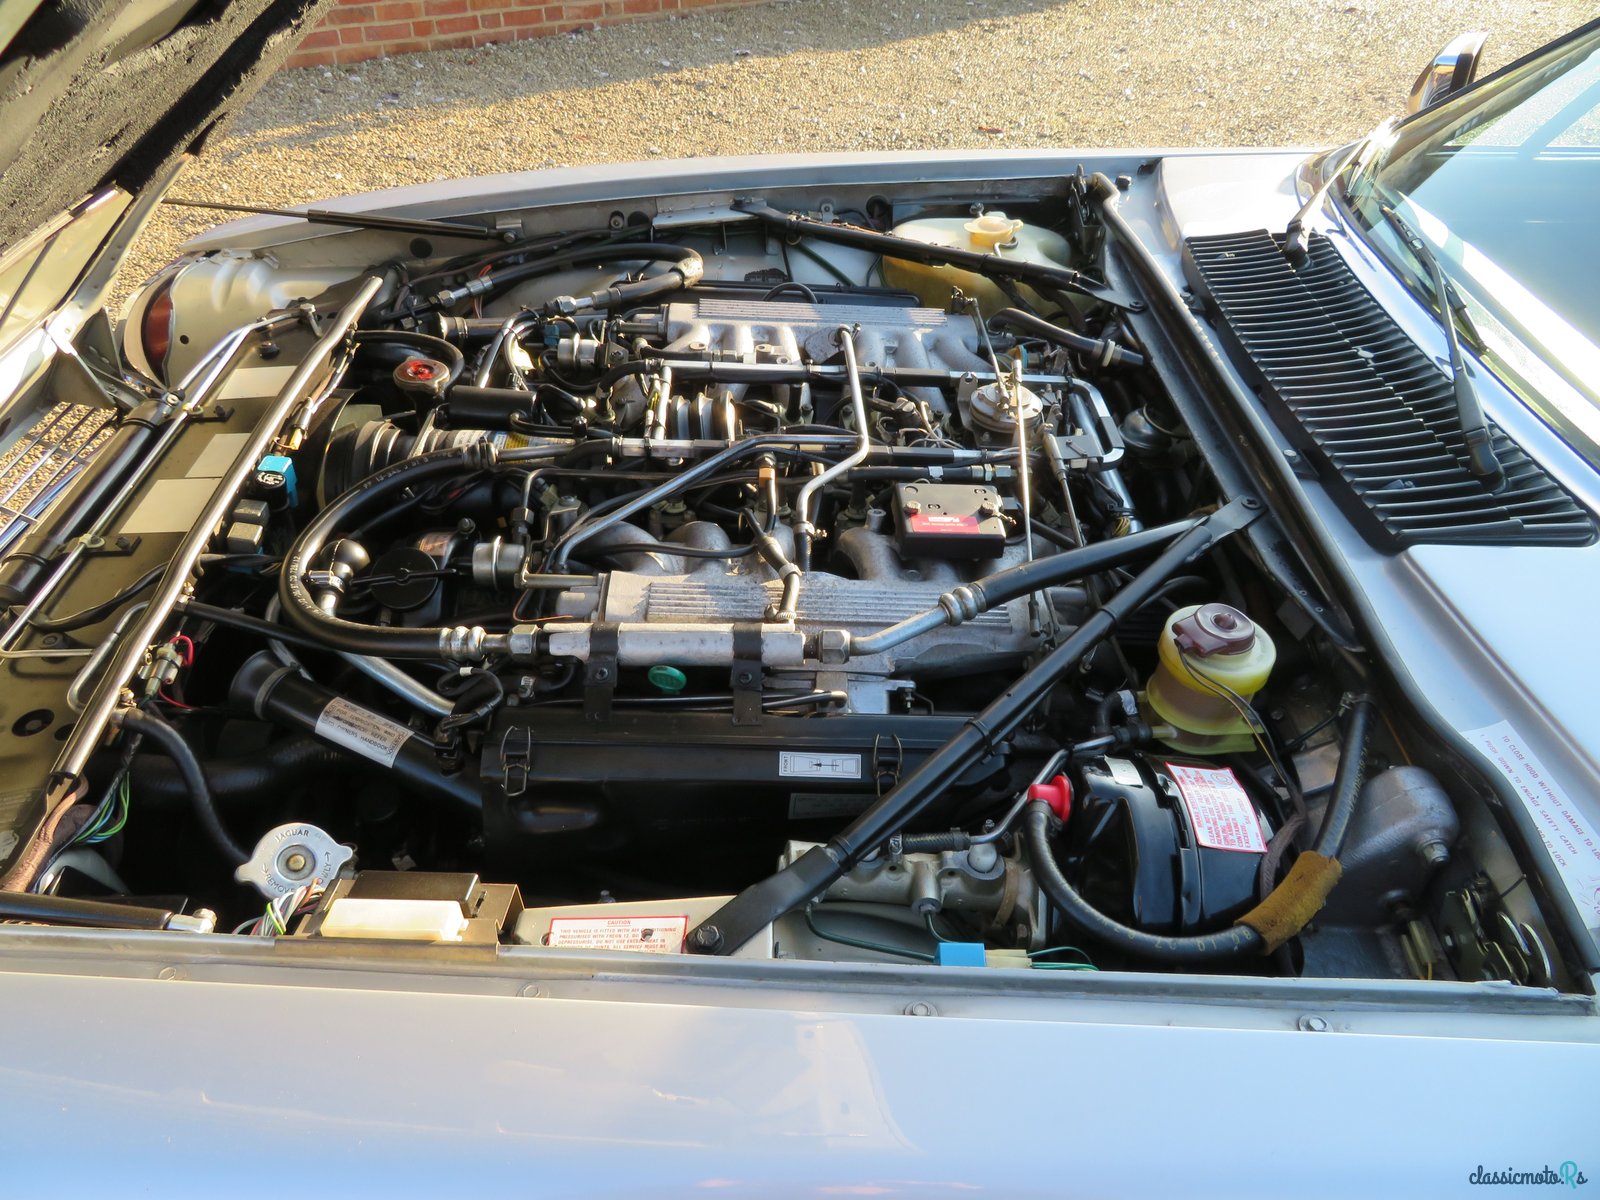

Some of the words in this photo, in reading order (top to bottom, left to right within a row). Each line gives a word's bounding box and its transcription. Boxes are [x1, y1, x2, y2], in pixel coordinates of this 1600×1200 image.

[1498, 757, 1513, 774] DOWN
[1521, 785, 1541, 808] ENGAGE
[1540, 810, 1560, 832] SAFETY
[1560, 835, 1578, 855] CATCH
[1509, 744, 1525, 761] CLOSE
[1524, 762, 1539, 779] HOOD
[1538, 780, 1563, 808] WITHOUT
[1562, 811, 1585, 837] DAMAGE
[1584, 838, 1593, 847] TO
[274, 829, 309, 842] JAGUAR
[1552, 850, 1568, 867] LOCK
